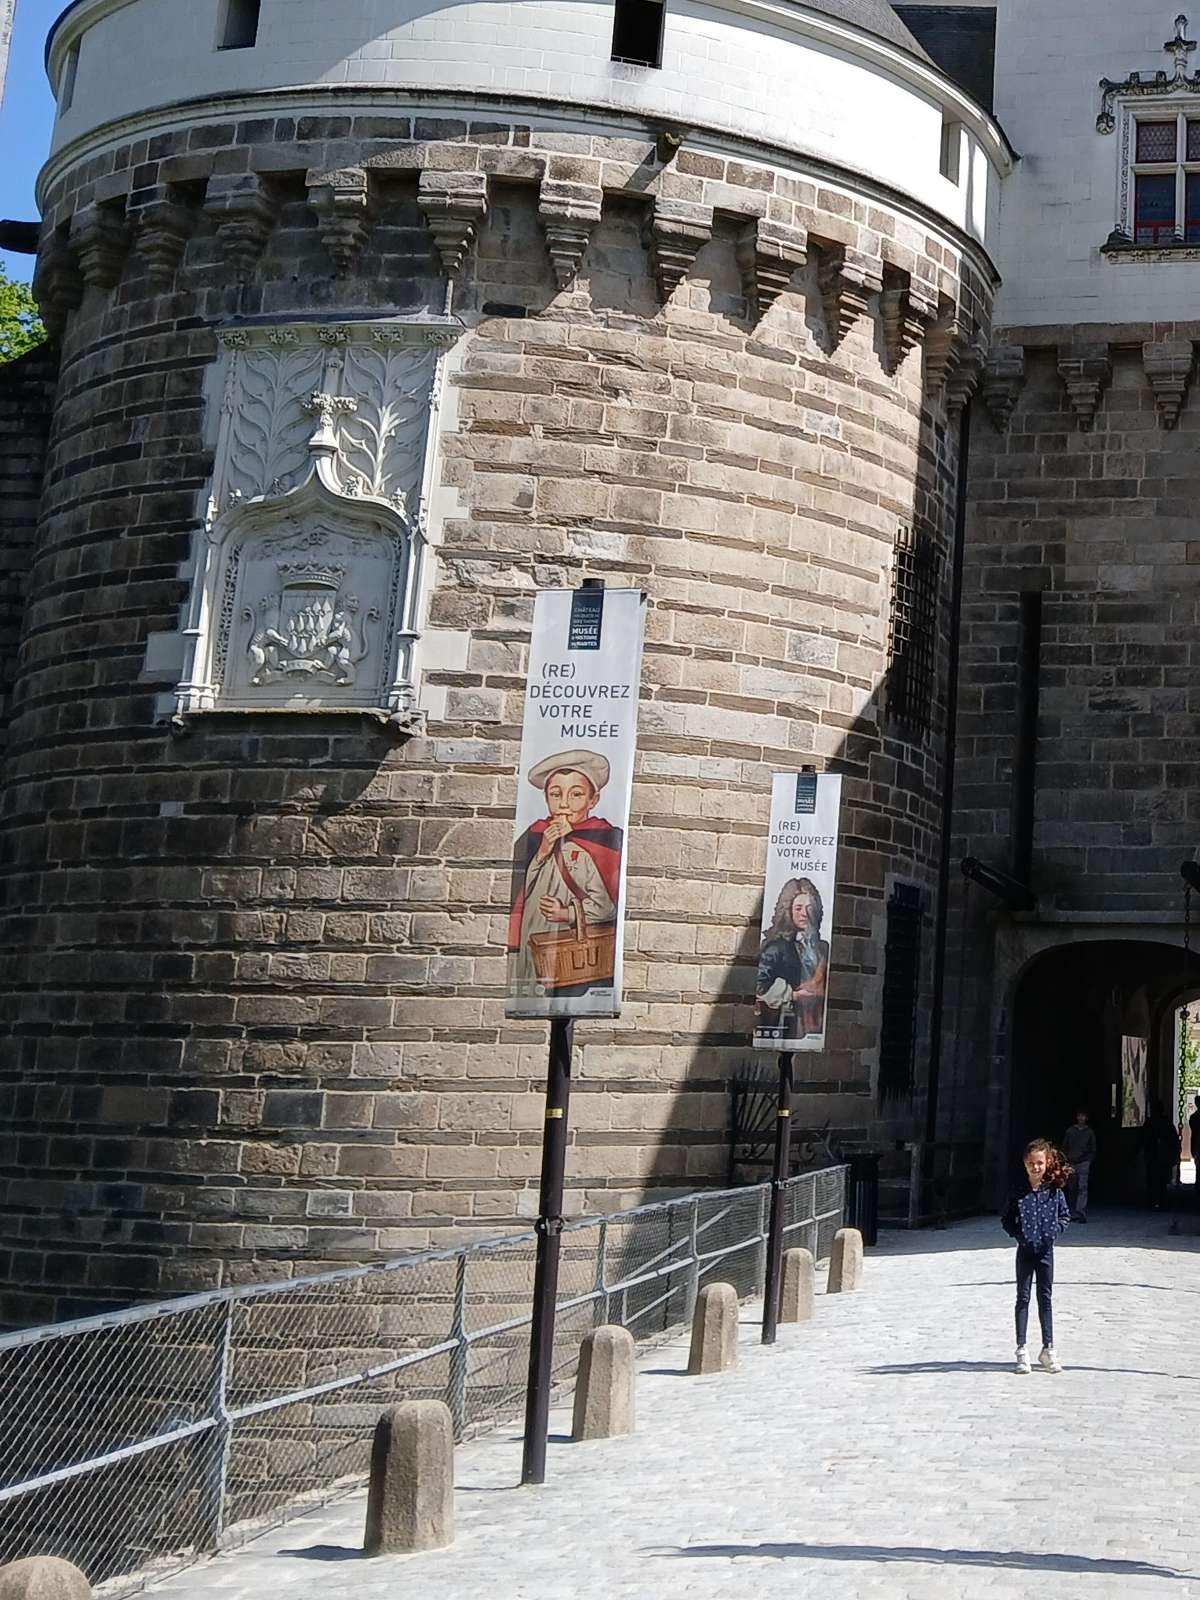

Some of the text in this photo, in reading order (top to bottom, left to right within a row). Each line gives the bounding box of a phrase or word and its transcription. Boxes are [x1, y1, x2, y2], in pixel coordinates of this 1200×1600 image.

[571, 626, 599, 635] MUSÉE
[542, 662, 576, 679] (RE)
[530, 681, 631, 698] DÉCOUVREZ
[539, 705, 593, 718] VOTRE
[560, 721, 620, 738] MUSÉE
[778, 821, 801, 831] (RE)
[771, 834, 835, 846] DÉCOUVREZ
[777, 848, 812, 858] VOTRE
[790, 860, 828, 871] MUSÉE
